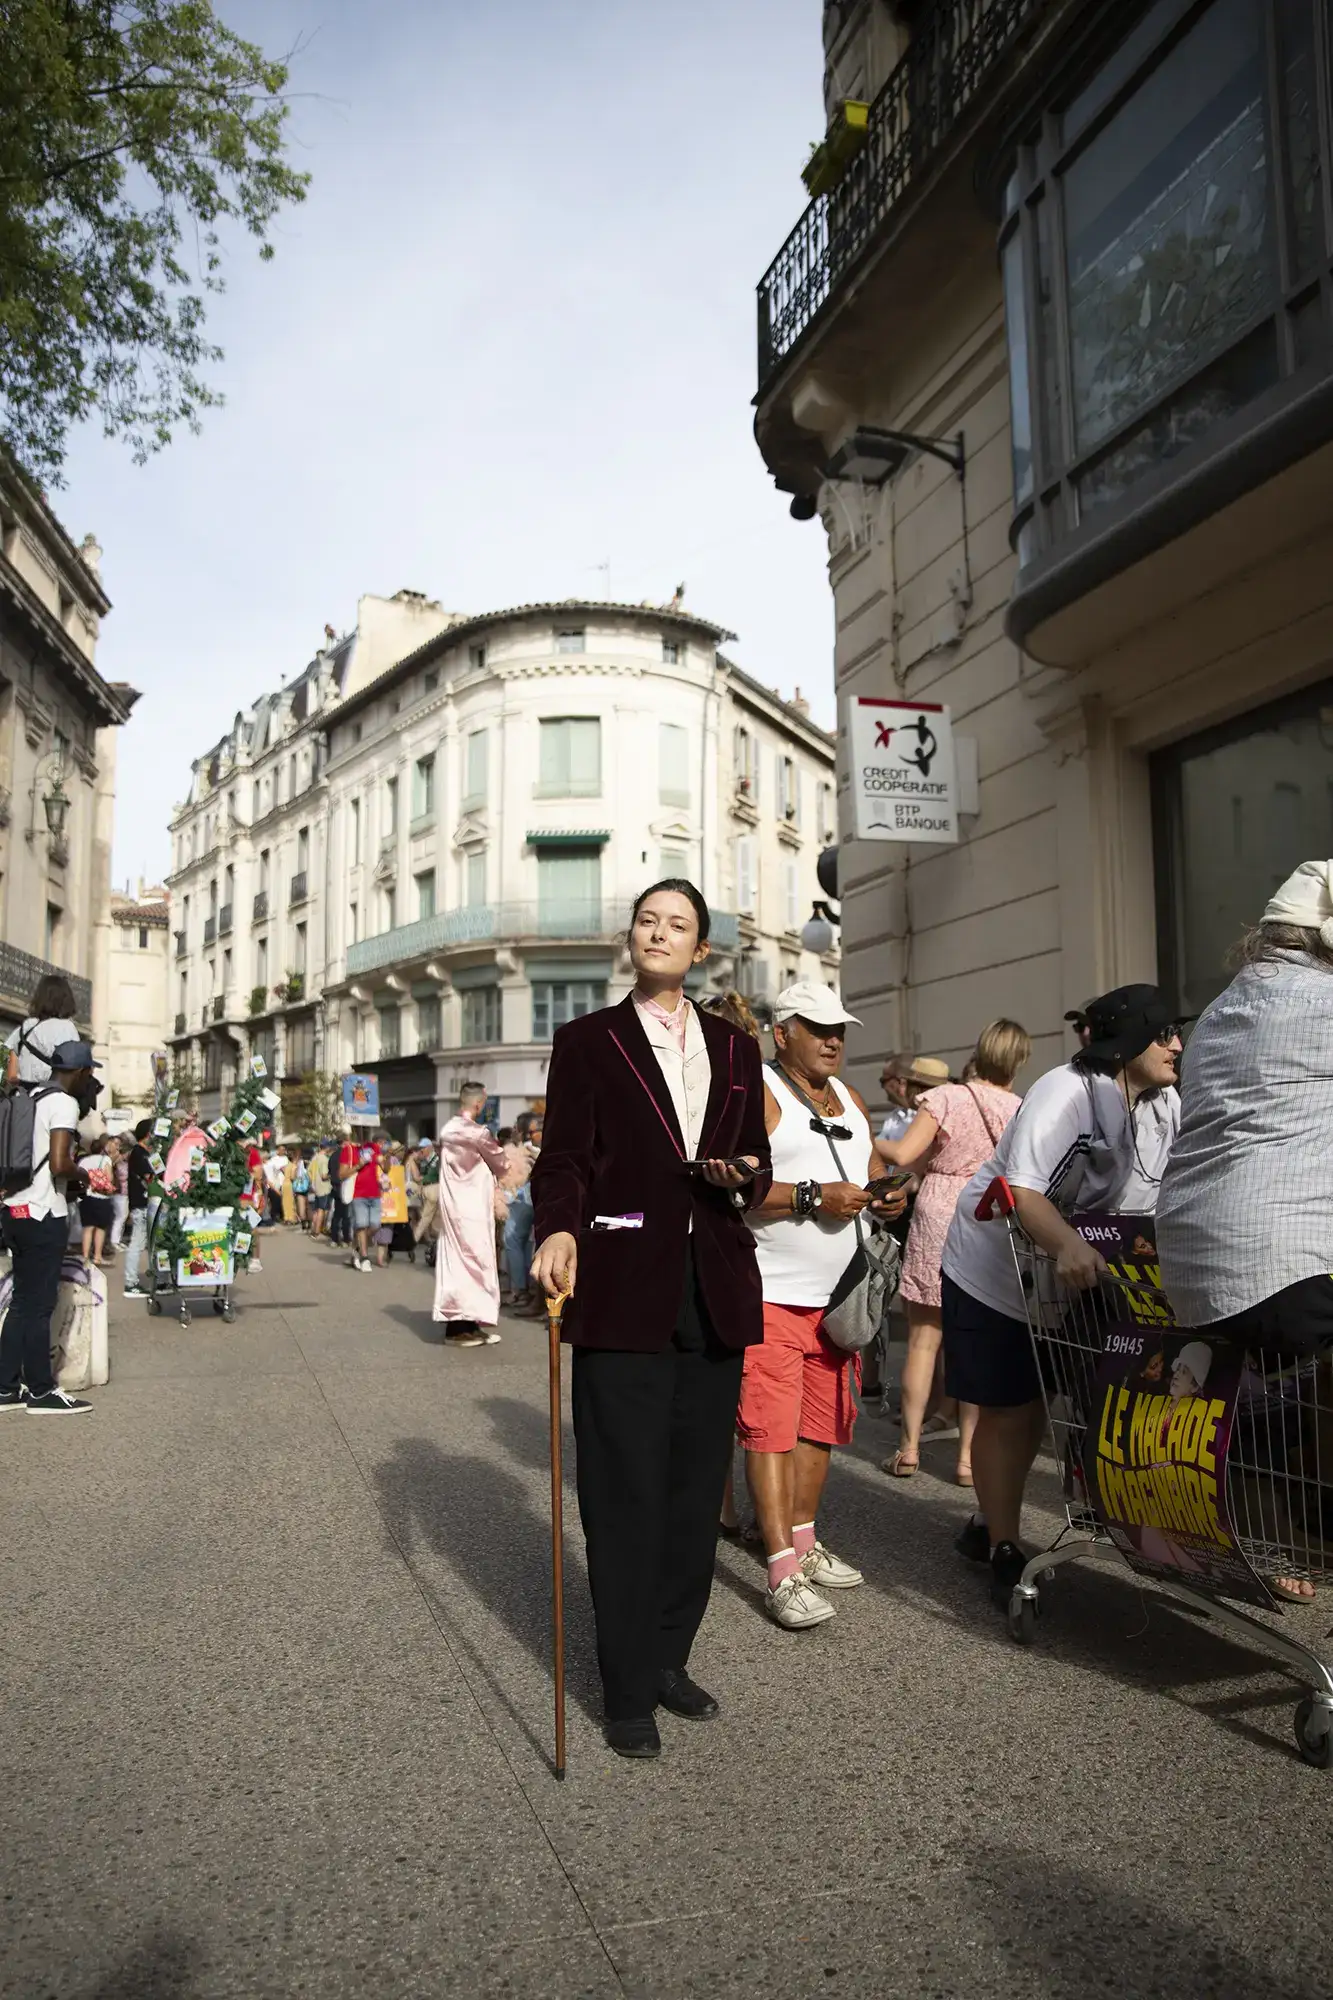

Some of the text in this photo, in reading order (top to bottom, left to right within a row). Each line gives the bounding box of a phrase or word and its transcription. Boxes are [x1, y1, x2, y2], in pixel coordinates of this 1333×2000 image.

[863, 766, 910, 781] CREDIT
[863, 779, 948, 795] COOPERATIF
[895, 804, 921, 815] BTP
[895, 817, 951, 831] BANQUE
[1077, 1226, 1122, 1242] 19H45
[1104, 1334, 1145, 1356] 19H45
[1098, 1384, 1226, 1474] LE MALADE
[1096, 1455, 1234, 1550] IMAGINAIRE
